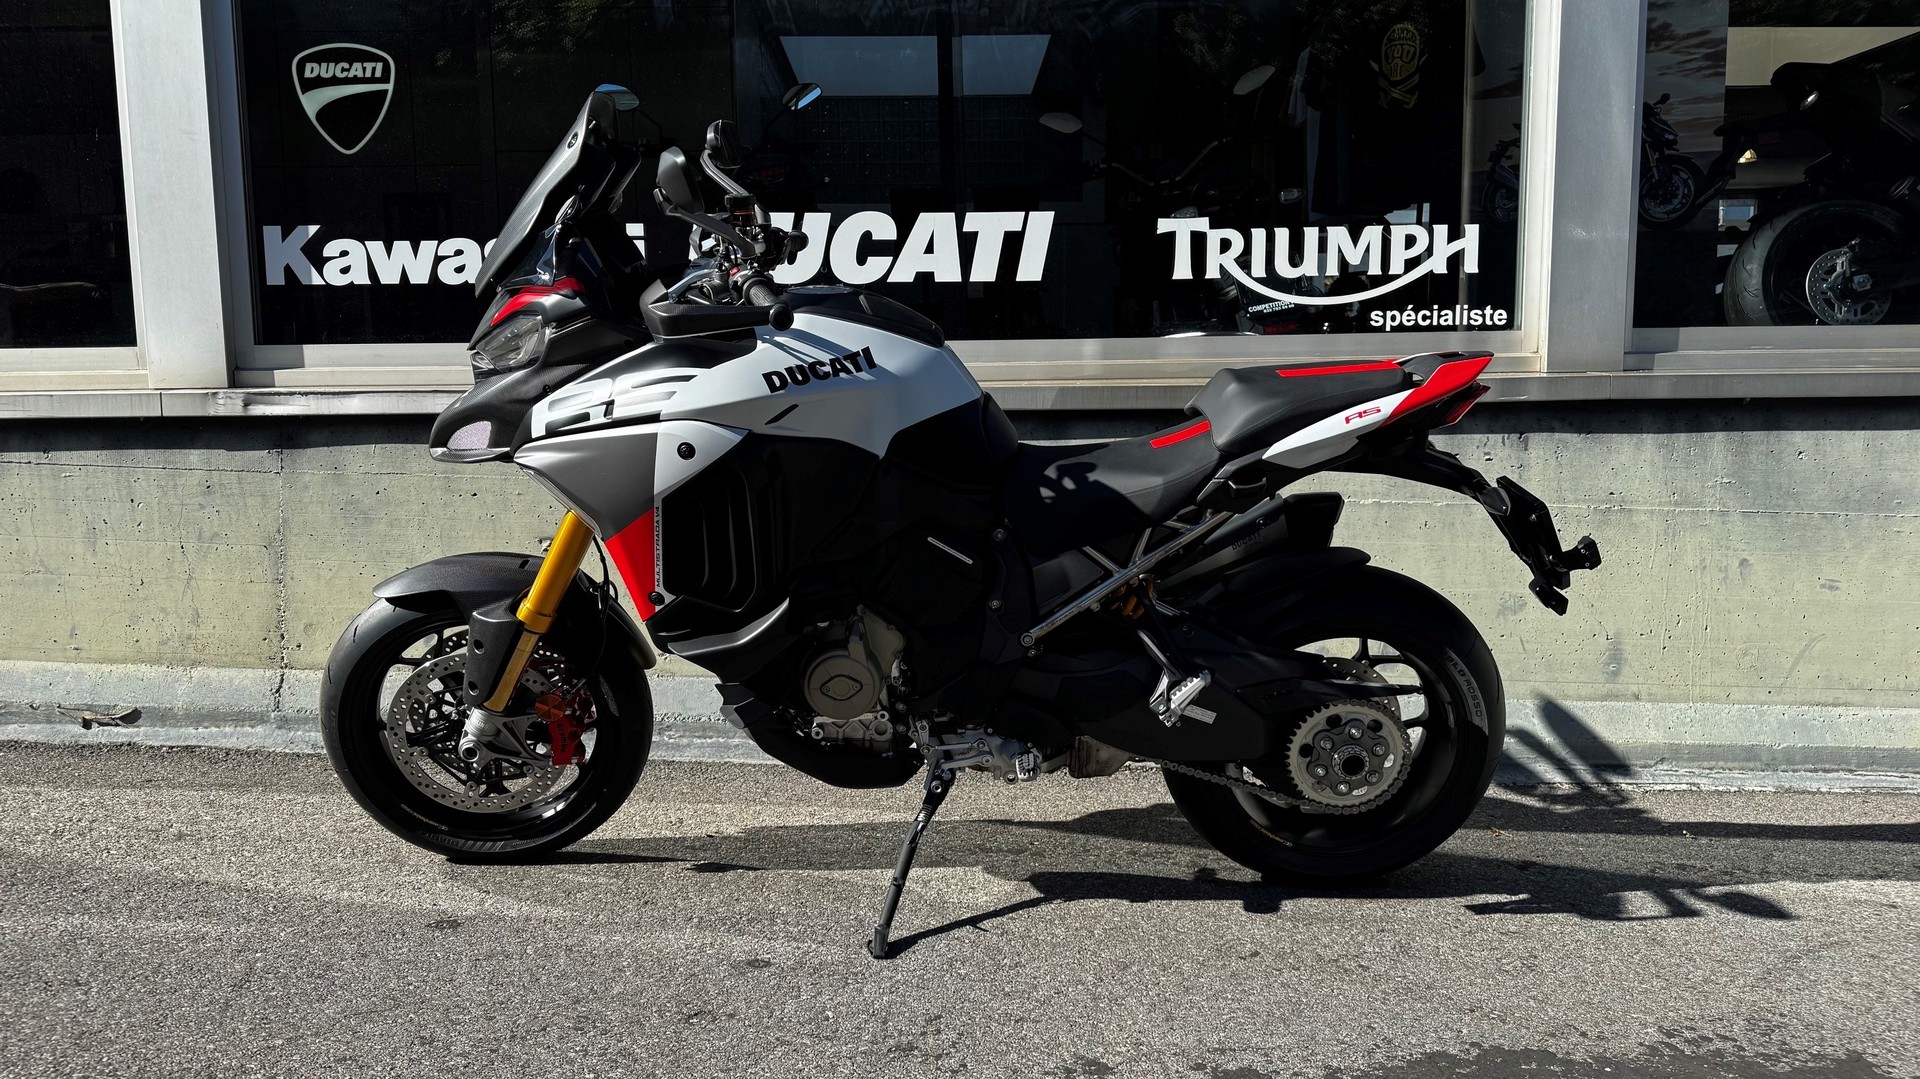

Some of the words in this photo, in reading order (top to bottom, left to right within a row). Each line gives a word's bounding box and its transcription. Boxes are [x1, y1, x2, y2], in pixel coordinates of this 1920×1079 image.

[304, 61, 384, 80] DUCATI
[262, 222, 645, 286] Kawa
[689, 210, 1055, 285] UCATI
[1157, 217, 1480, 305] TRIUMPH
[1370, 304, 1509, 331] spécialiste
[761, 345, 877, 394] DUCATI
[1345, 406, 1381, 425] RS
[655, 507, 660, 518] V4
[1464, 679, 1483, 718] ROSSO
